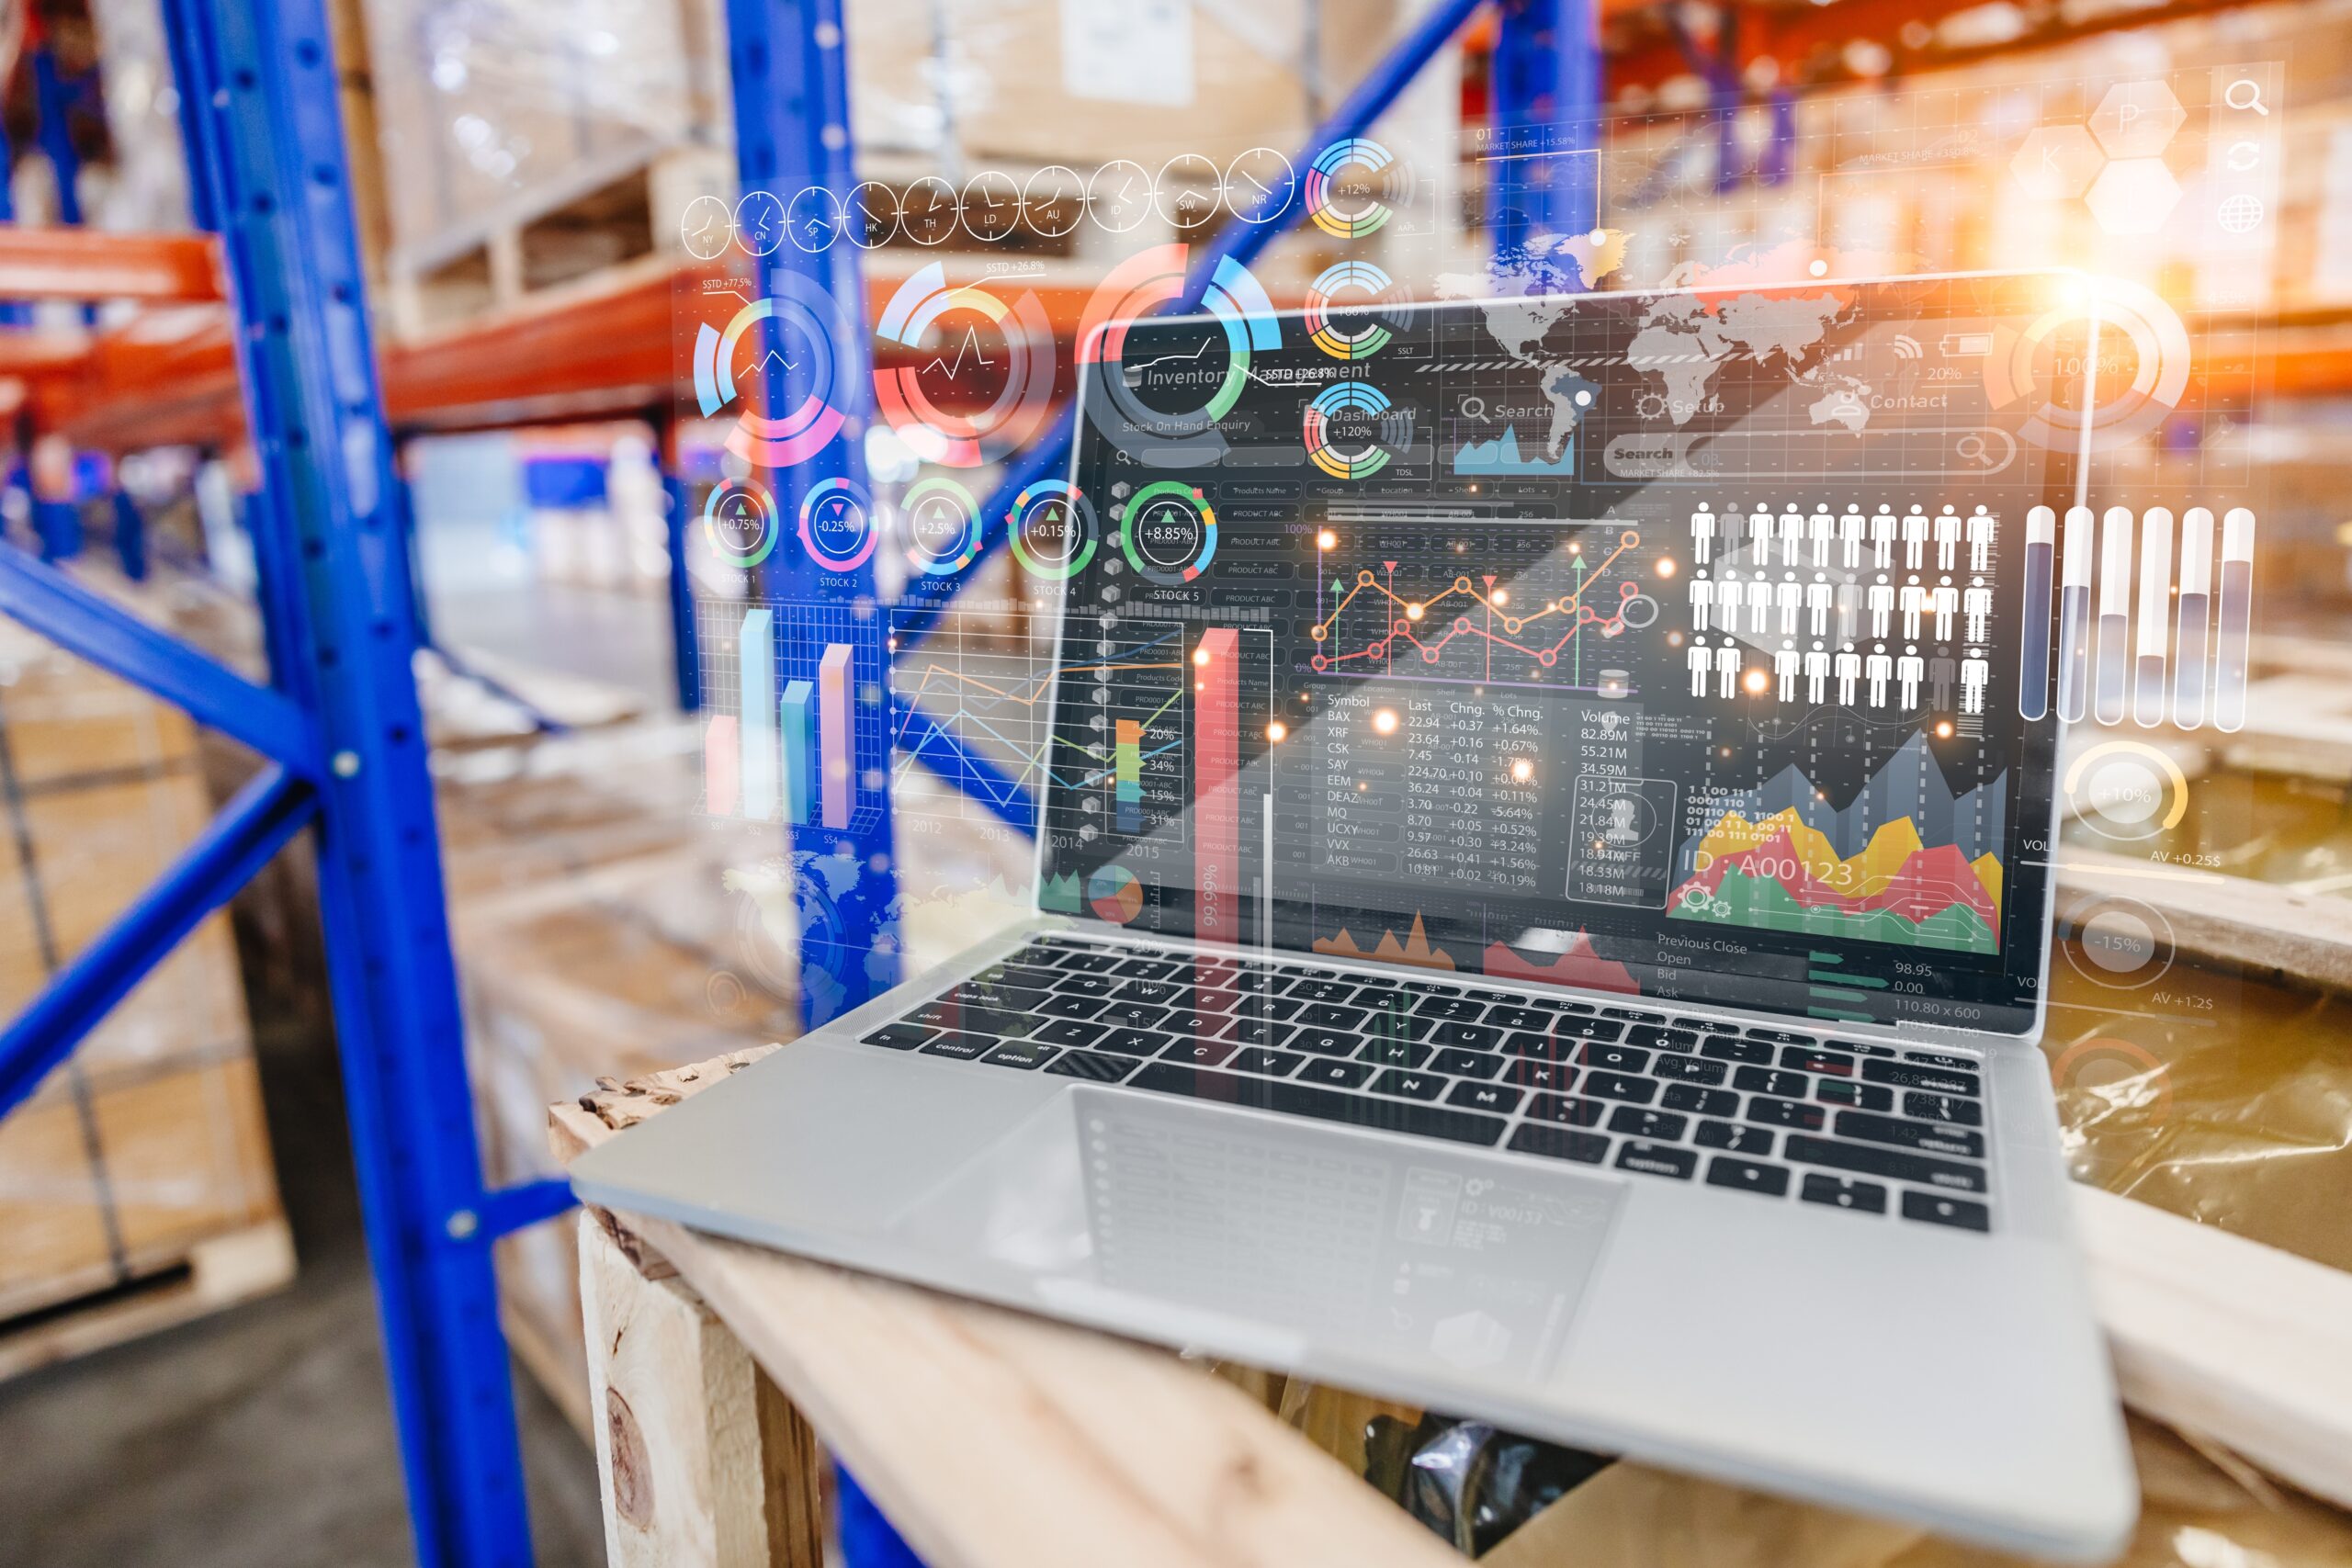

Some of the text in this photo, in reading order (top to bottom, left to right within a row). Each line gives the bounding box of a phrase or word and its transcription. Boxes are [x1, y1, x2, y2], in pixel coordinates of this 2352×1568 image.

[1148, 367, 1235, 386] Inventory
[1671, 399, 1724, 416] Setup
[1871, 394, 1948, 409] Contact
[1332, 408, 1416, 423] Dashboard
[1495, 403, 1554, 418] Search
[1122, 420, 1250, 433] Stock On Hand Enquiry
[1614, 447, 1673, 459] Search
[1235, 487, 1264, 495] Products
[1266, 487, 1286, 495] Name
[1321, 487, 1343, 495] Group
[1519, 486, 1535, 494] Lots
[1136, 673, 1163, 682] Products
[1684, 850, 1713, 872] ID
[1738, 855, 1852, 886] A00123
[955, 992, 1000, 1002] caps lock
[918, 1012, 943, 1021] shift
[935, 1043, 975, 1055] control
[998, 1054, 1033, 1064] option
